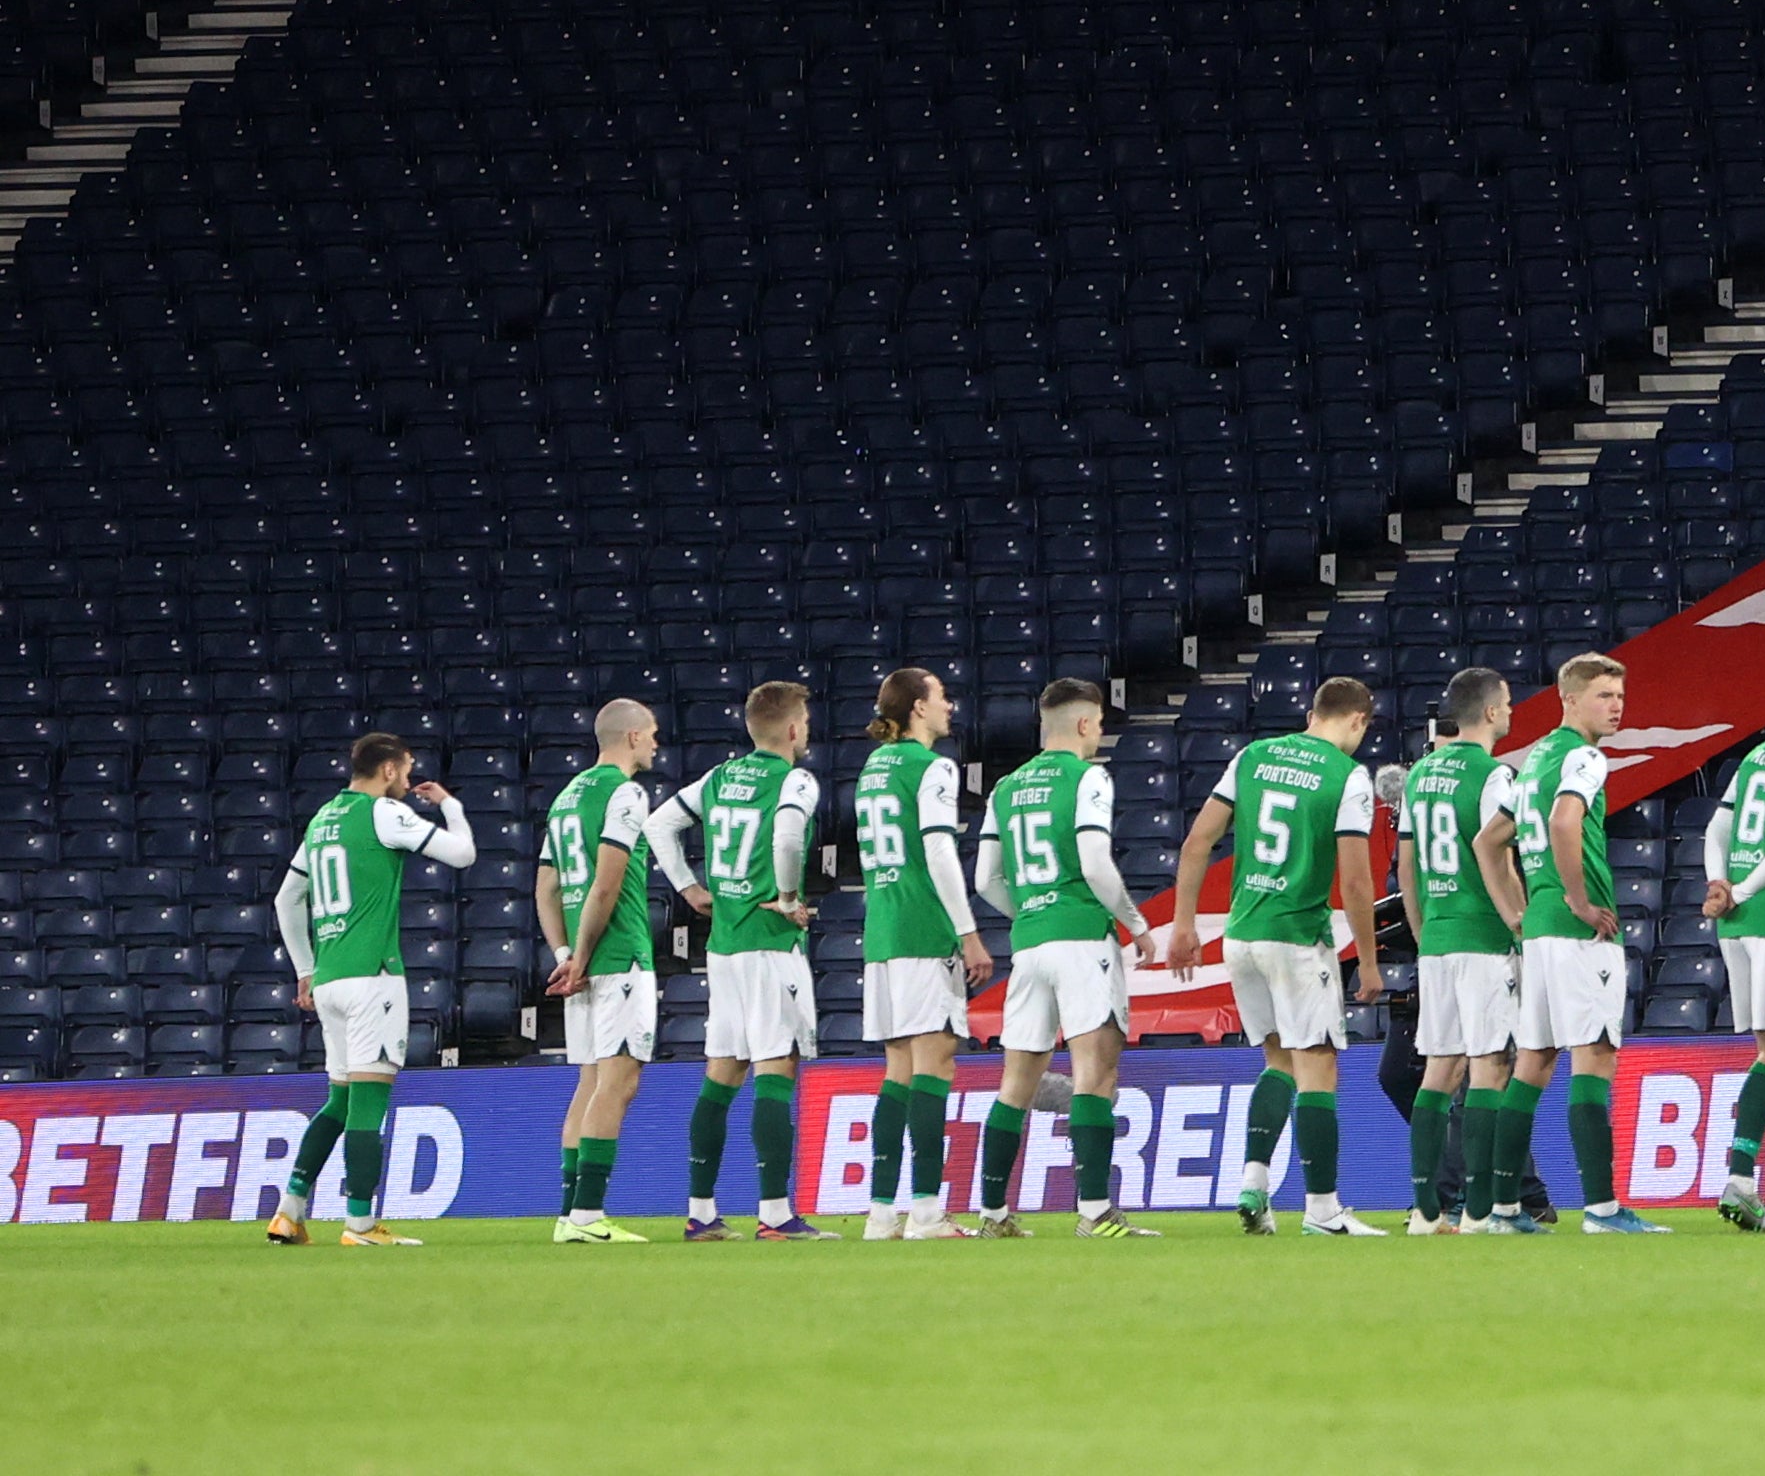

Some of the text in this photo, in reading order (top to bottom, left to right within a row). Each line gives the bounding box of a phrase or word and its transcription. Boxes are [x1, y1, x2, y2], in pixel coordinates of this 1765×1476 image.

[1253, 763, 1323, 792] PORTEOUS
[1299, 750, 1327, 765] MILL
[1011, 786, 1054, 808] NISBET
[1253, 788, 1298, 867] 5
[548, 813, 589, 888] 13
[708, 804, 762, 881] 27
[1007, 810, 1060, 888] 15
[1411, 799, 1461, 876] 18
[308, 843, 353, 920] 10
[0, 1105, 465, 1224] ETFRD
